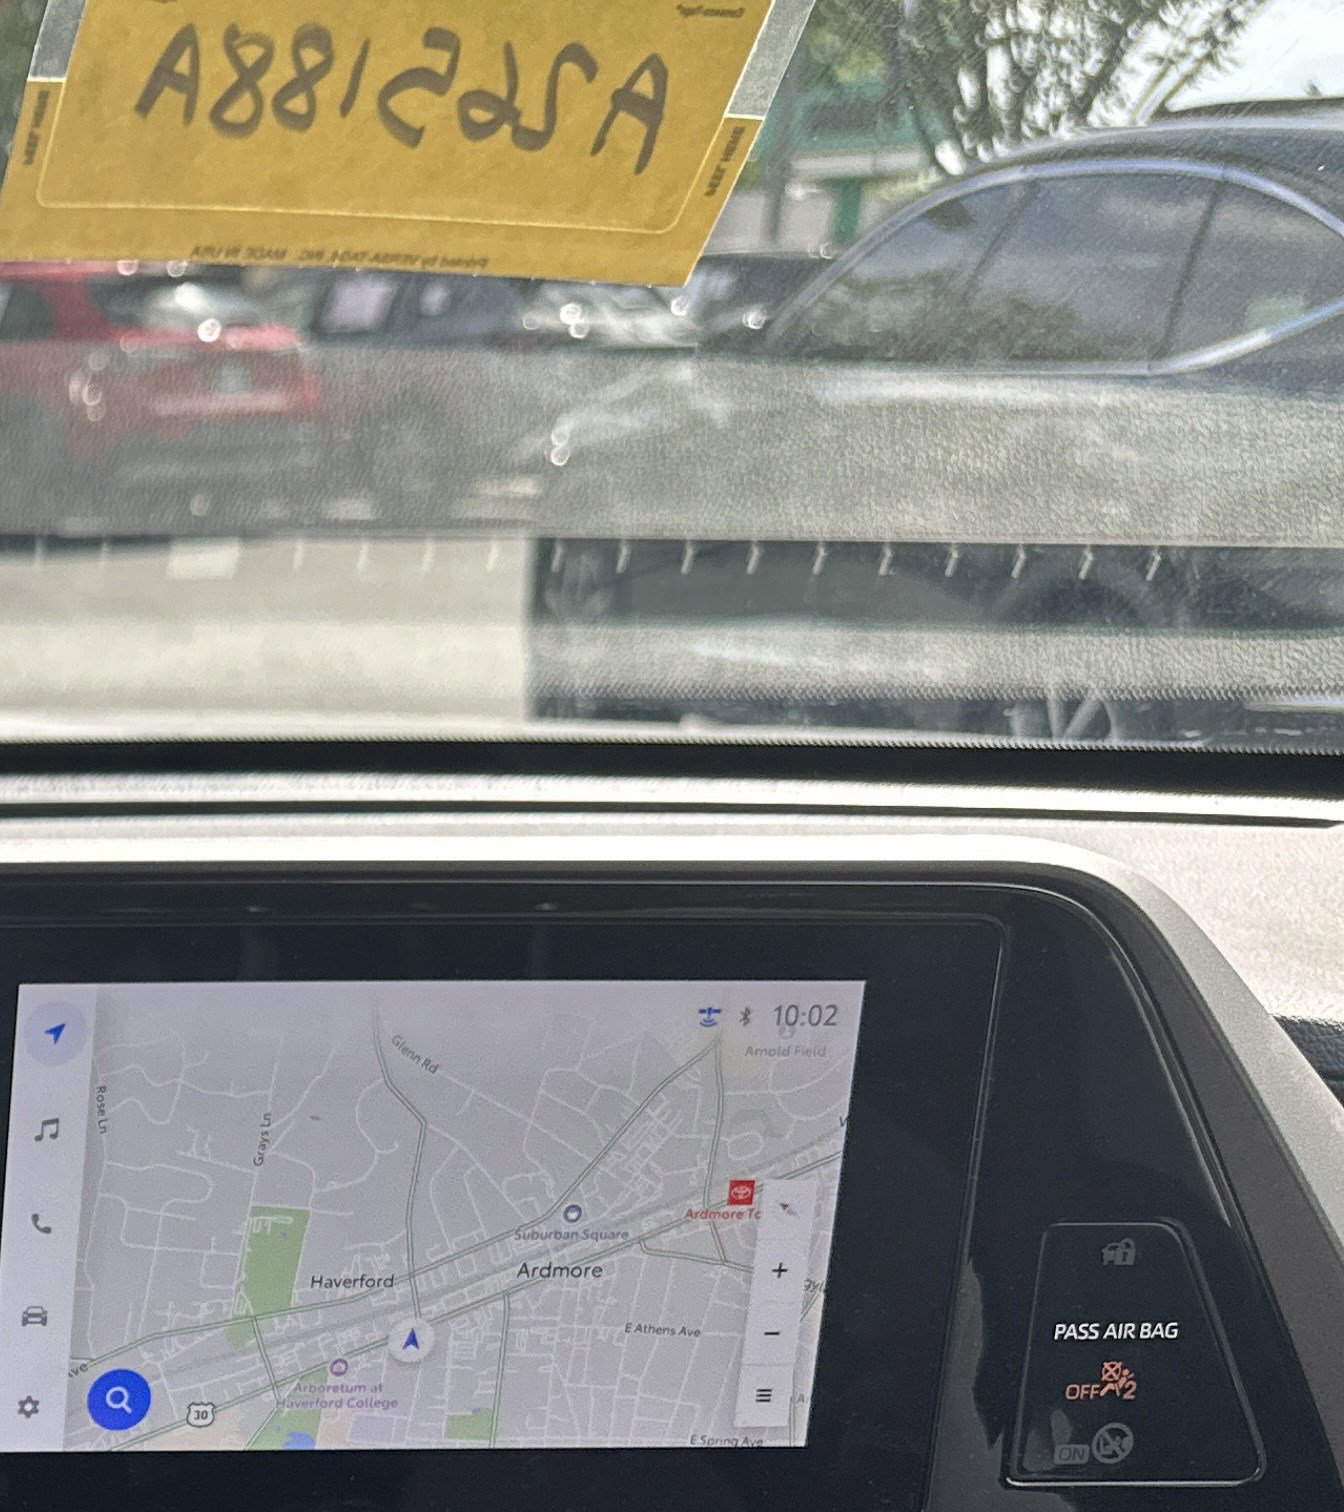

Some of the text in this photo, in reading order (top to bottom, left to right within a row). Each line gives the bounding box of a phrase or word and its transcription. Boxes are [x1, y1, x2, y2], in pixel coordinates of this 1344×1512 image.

[774, 1004, 838, 1026] 10:02
[794, 1045, 826, 1057] Field
[422, 1058, 439, 1074] Rd
[96, 1085, 109, 1135] Rose Ln
[253, 1113, 272, 1167] Grays Ln
[684, 1208, 745, 1220] Ardmore
[514, 1227, 630, 1243] Suburban Square
[516, 1262, 604, 1280] Ardmore
[310, 1274, 396, 1290] Haverford
[624, 1323, 703, 1338] E Athens Ave
[1054, 1322, 1179, 1340] PASS AIR BAG
[371, 1382, 384, 1395] at
[1065, 1384, 1102, 1401] OFF
[276, 1395, 399, 1410] Haverford College
[193, 1410, 209, 1421] 30
[689, 1434, 698, 1445] E
[740, 1436, 764, 1447] Ave
